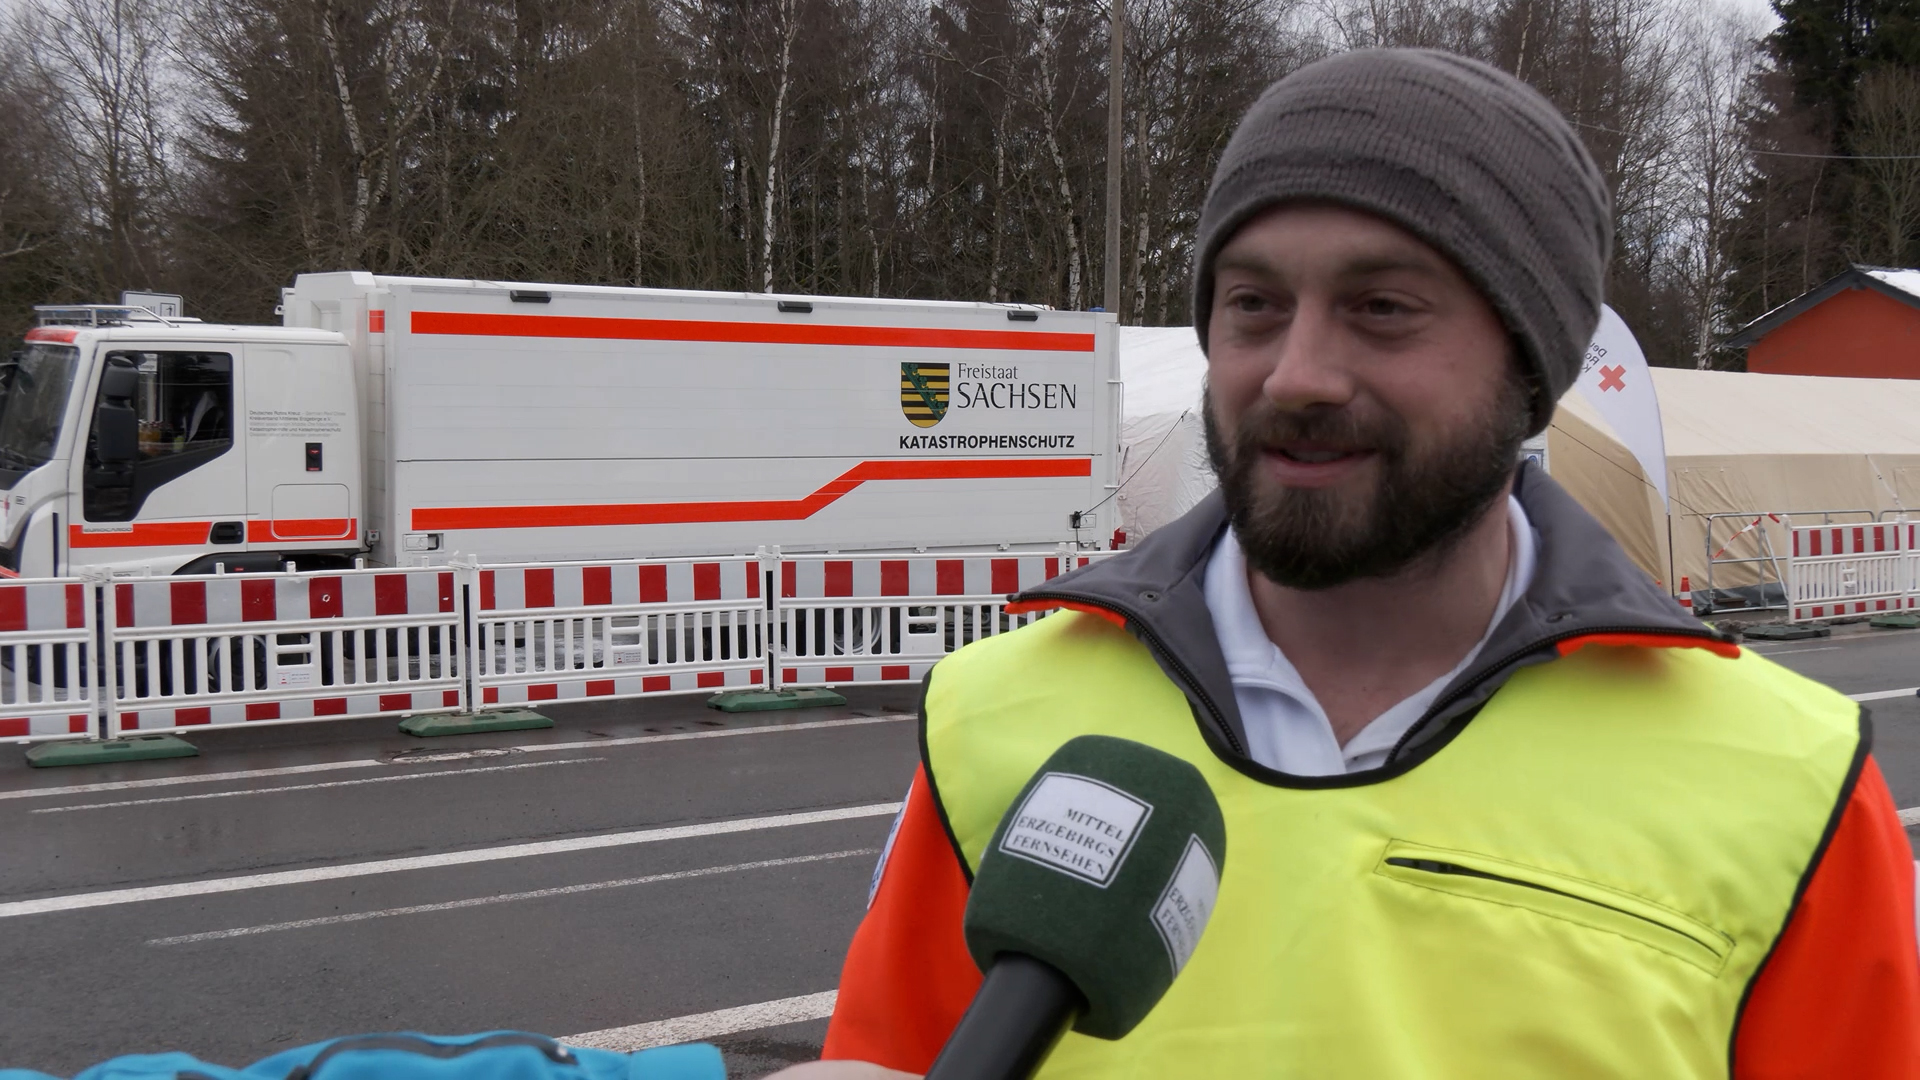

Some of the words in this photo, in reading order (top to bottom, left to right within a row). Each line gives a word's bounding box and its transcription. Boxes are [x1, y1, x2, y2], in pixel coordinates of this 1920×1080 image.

[957, 362, 1019, 380] Freistaat
[957, 382, 1076, 409] SACHSEN
[899, 434, 1075, 449] KATASTROPHENSCHUTZ
[1016, 816, 1116, 858] ERZGEBIRGS
[1065, 808, 1125, 842] MITTEL
[1011, 834, 1108, 876] FERNSEHEN
